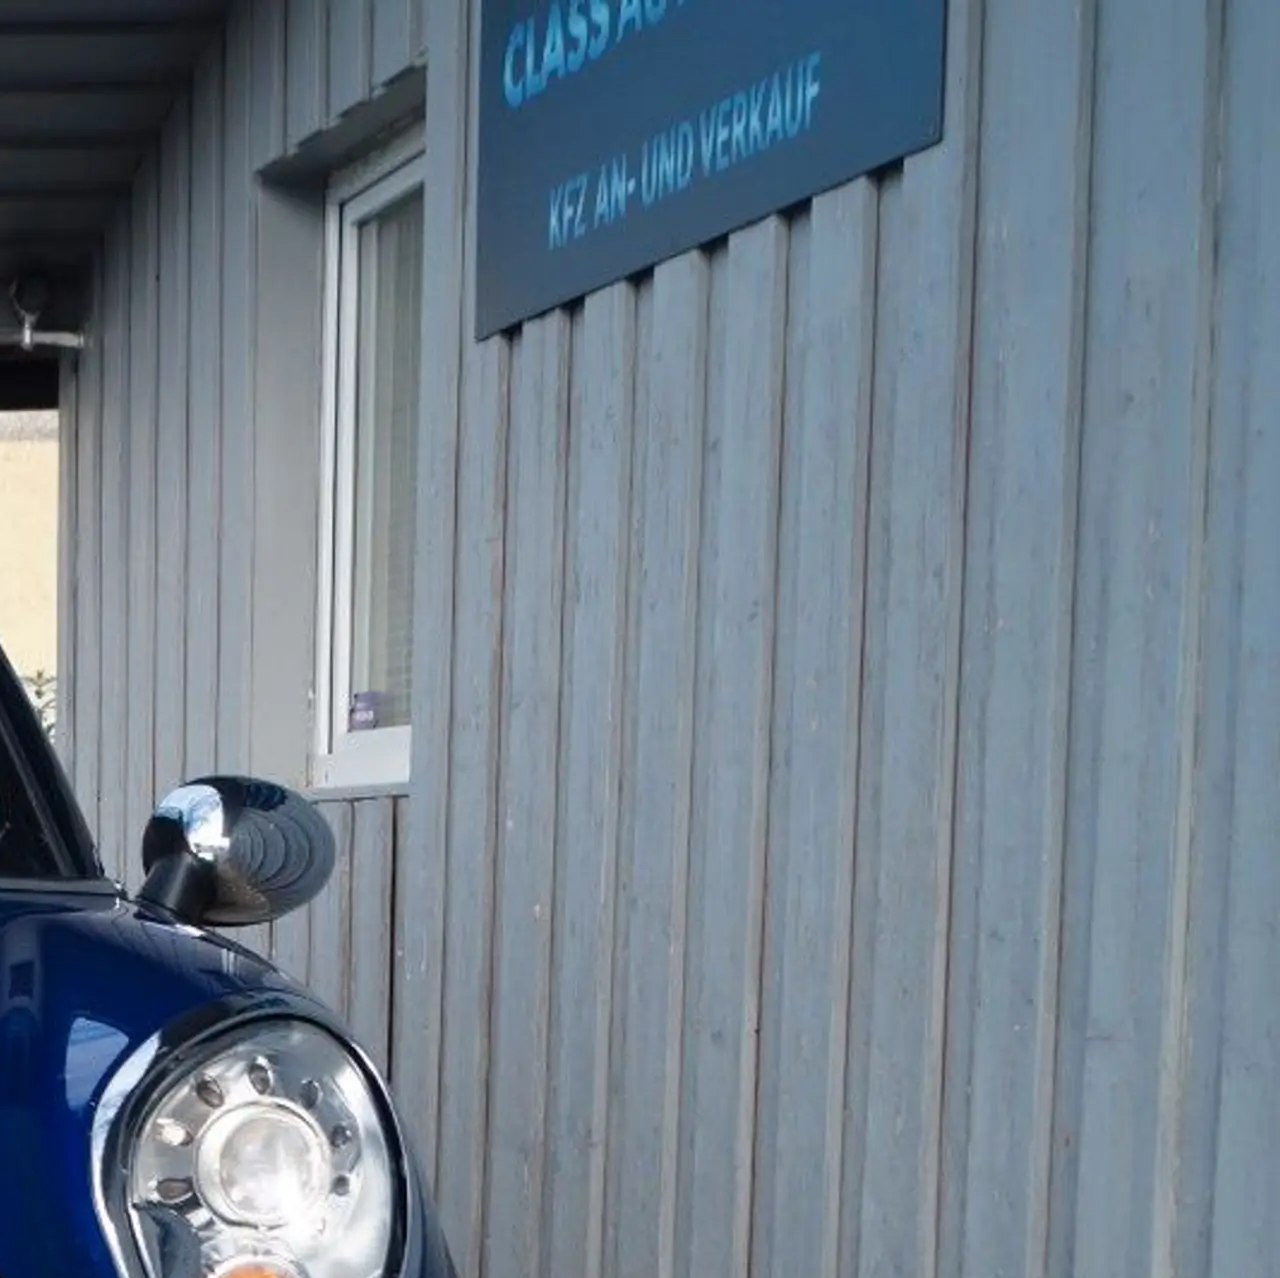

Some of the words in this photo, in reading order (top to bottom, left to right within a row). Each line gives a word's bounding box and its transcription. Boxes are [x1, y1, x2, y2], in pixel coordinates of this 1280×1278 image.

[504, 0, 610, 107] CLASS
[549, 172, 589, 250] KFZ
[594, 153, 636, 229] AN-
[642, 121, 694, 209] UND
[699, 52, 821, 176] VERKAUF
